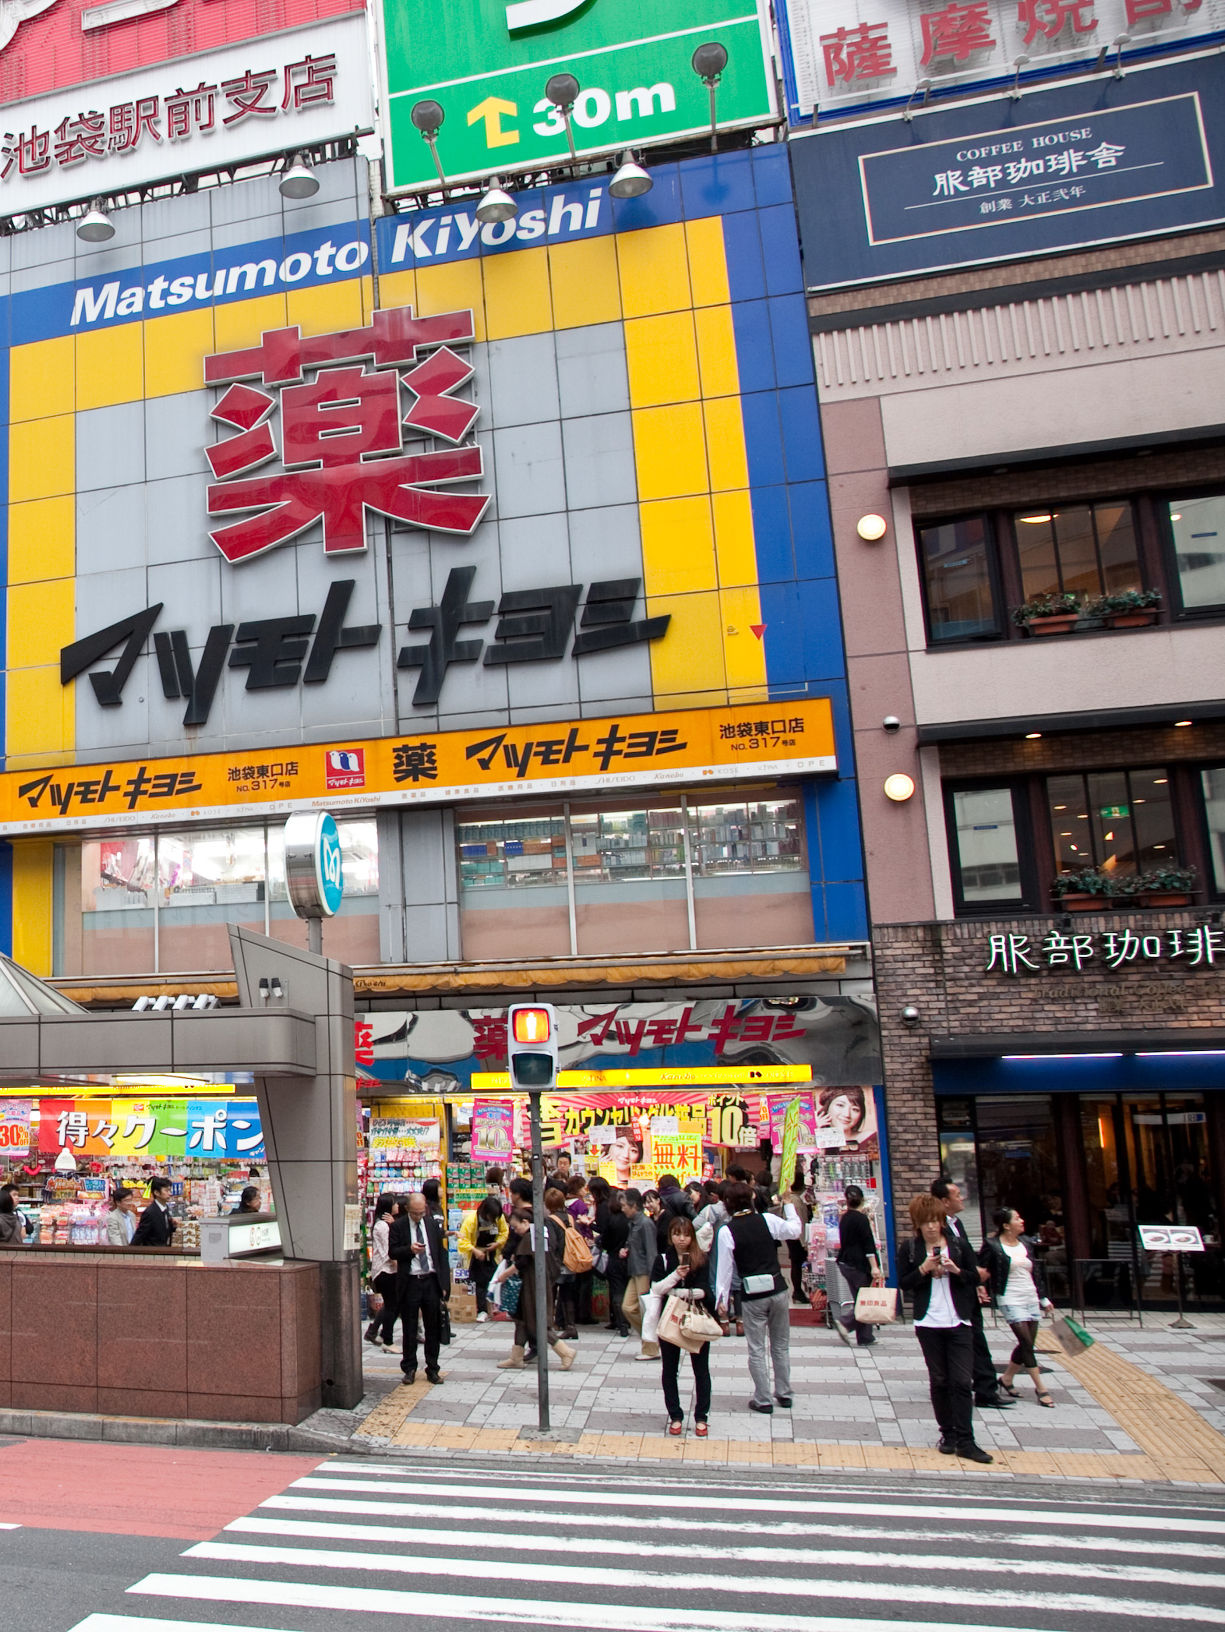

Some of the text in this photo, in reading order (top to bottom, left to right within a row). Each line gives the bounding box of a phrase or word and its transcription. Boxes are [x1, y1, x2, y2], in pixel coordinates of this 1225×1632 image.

[0, 53, 338, 181] 池袋駅前支店
[532, 82, 676, 137] 30m
[956, 127, 1093, 162] COFFEE HOUSE
[70, 240, 370, 327] Matsumoto
[203, 304, 492, 565] 薬
[60, 565, 672, 726] マツモトキヨシ
[719, 718, 804, 739] 池袋東口店
[227, 762, 299, 781] 池袋東口店
[391, 724, 688, 784] 薬 マツモトキヨシ
[18, 766, 203, 815] マツモトキヨシ
[577, 1004, 807, 1056] マツモトキヨシ
[707, 1091, 744, 1107] ポイント
[56, 1109, 264, 1151] 得々クーポン
[651, 1140, 702, 1171] 無料
